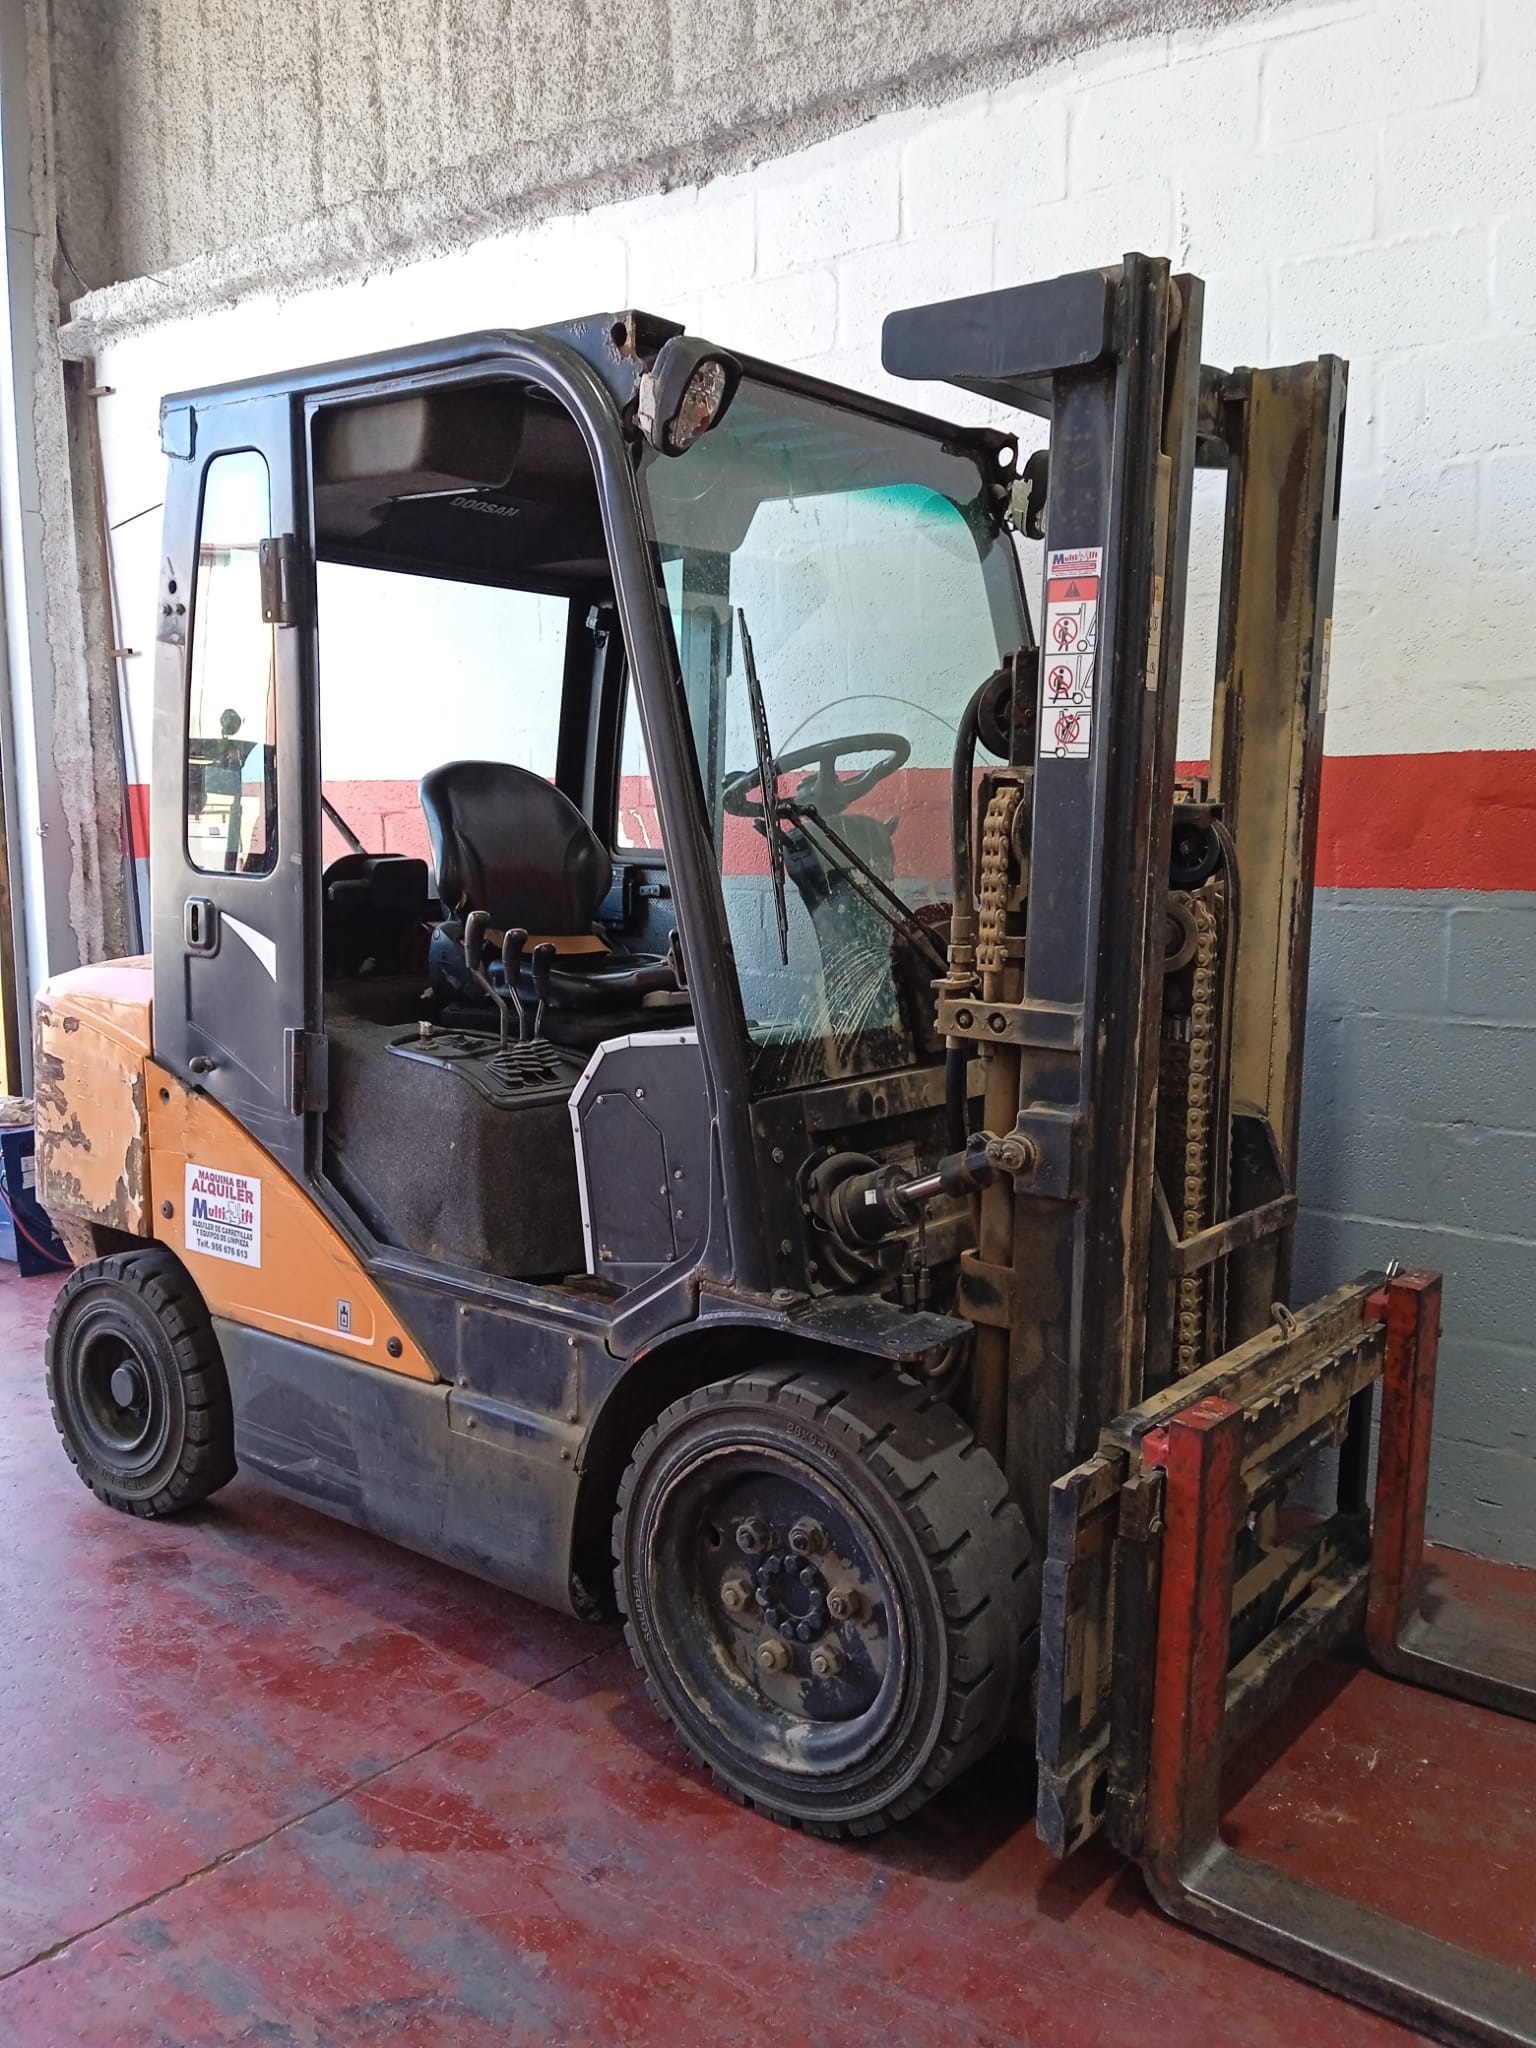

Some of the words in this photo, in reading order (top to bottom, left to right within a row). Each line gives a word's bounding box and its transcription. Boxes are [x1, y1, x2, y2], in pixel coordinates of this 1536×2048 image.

[449, 496, 520, 516] DOOSAN
[198, 1169, 234, 1187] MAQUINA
[236, 1179, 248, 1190] EN
[191, 1178, 254, 1205] ALQUILER
[192, 1219, 214, 1232] ALQUILER
[214, 1225, 222, 1234] DE
[221, 1227, 253, 1242] CARRETILLAS
[199, 1229, 220, 1241] EQUIPOS
[220, 1234, 227, 1243] DE
[211, 1241, 223, 1253] 956
[223, 1245, 235, 1257] 676
[631, 1570, 652, 1642] SOLIDEAL
